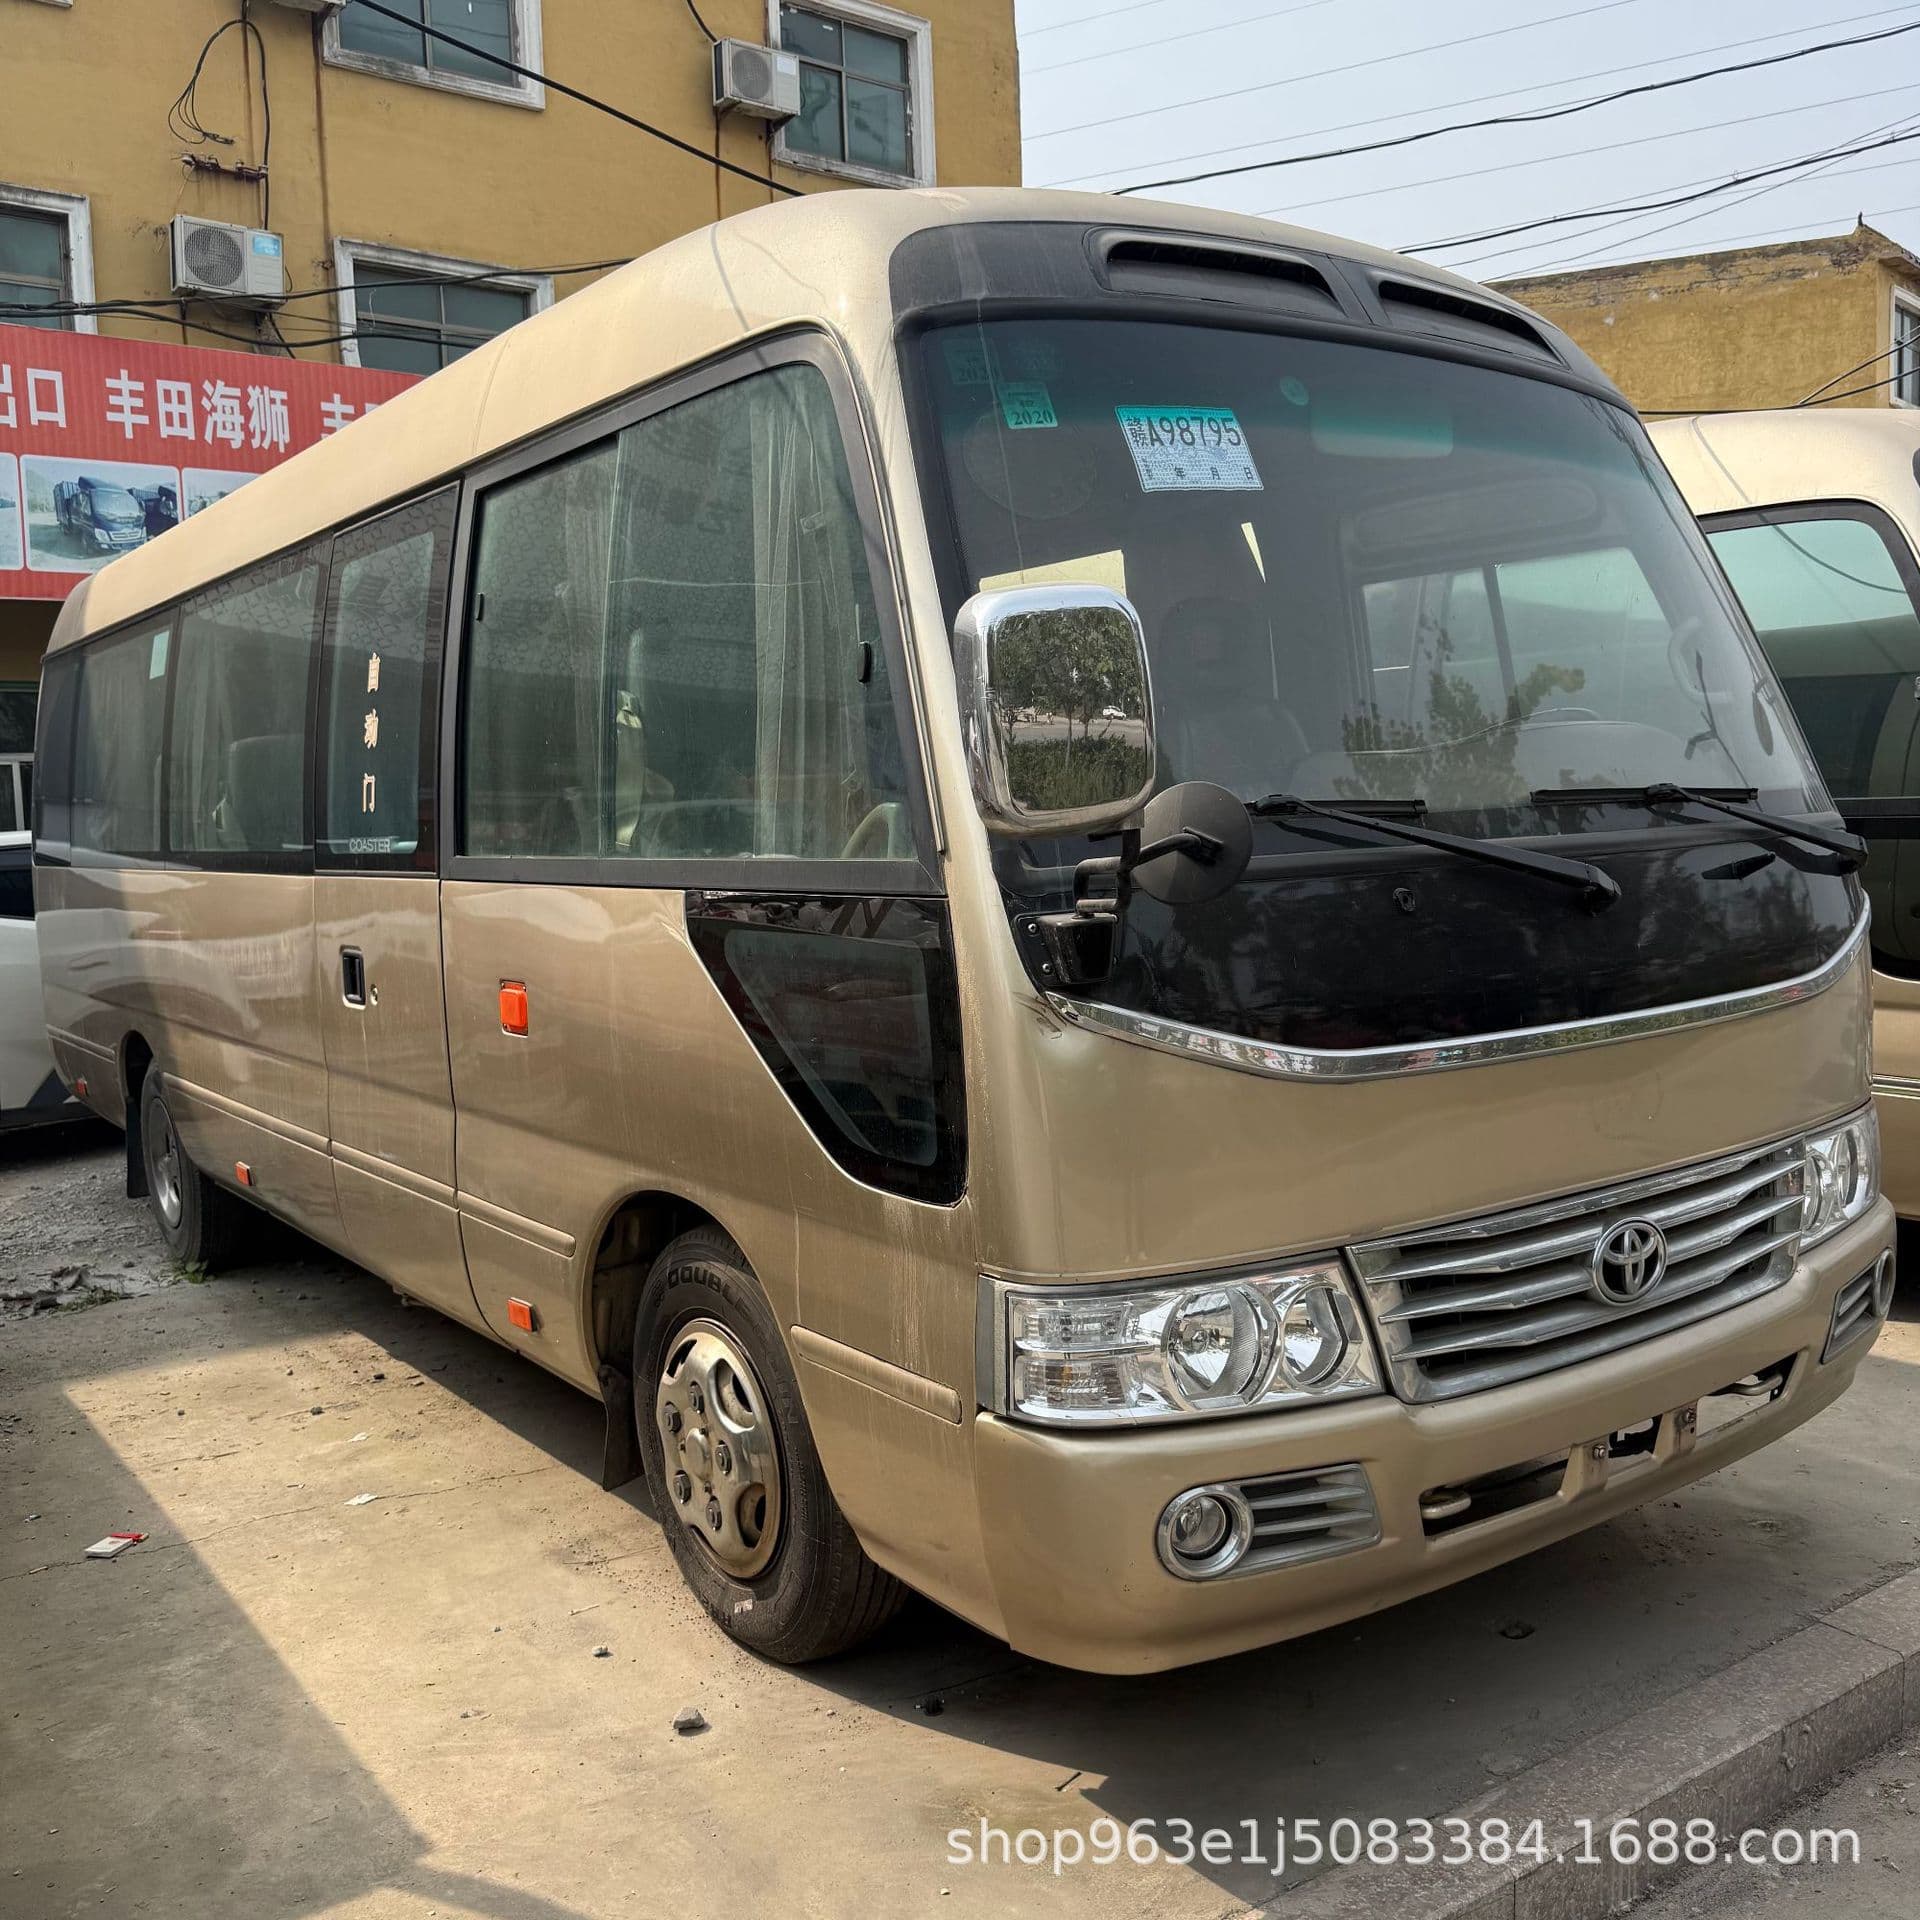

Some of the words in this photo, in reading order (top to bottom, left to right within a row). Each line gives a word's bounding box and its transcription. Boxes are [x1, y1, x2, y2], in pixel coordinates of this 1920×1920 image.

[105, 369, 291, 453] 丰田海狮
[320, 393, 381, 440] 丰
[1012, 409, 1054, 425] 2020
[349, 838, 391, 853] COASTER
